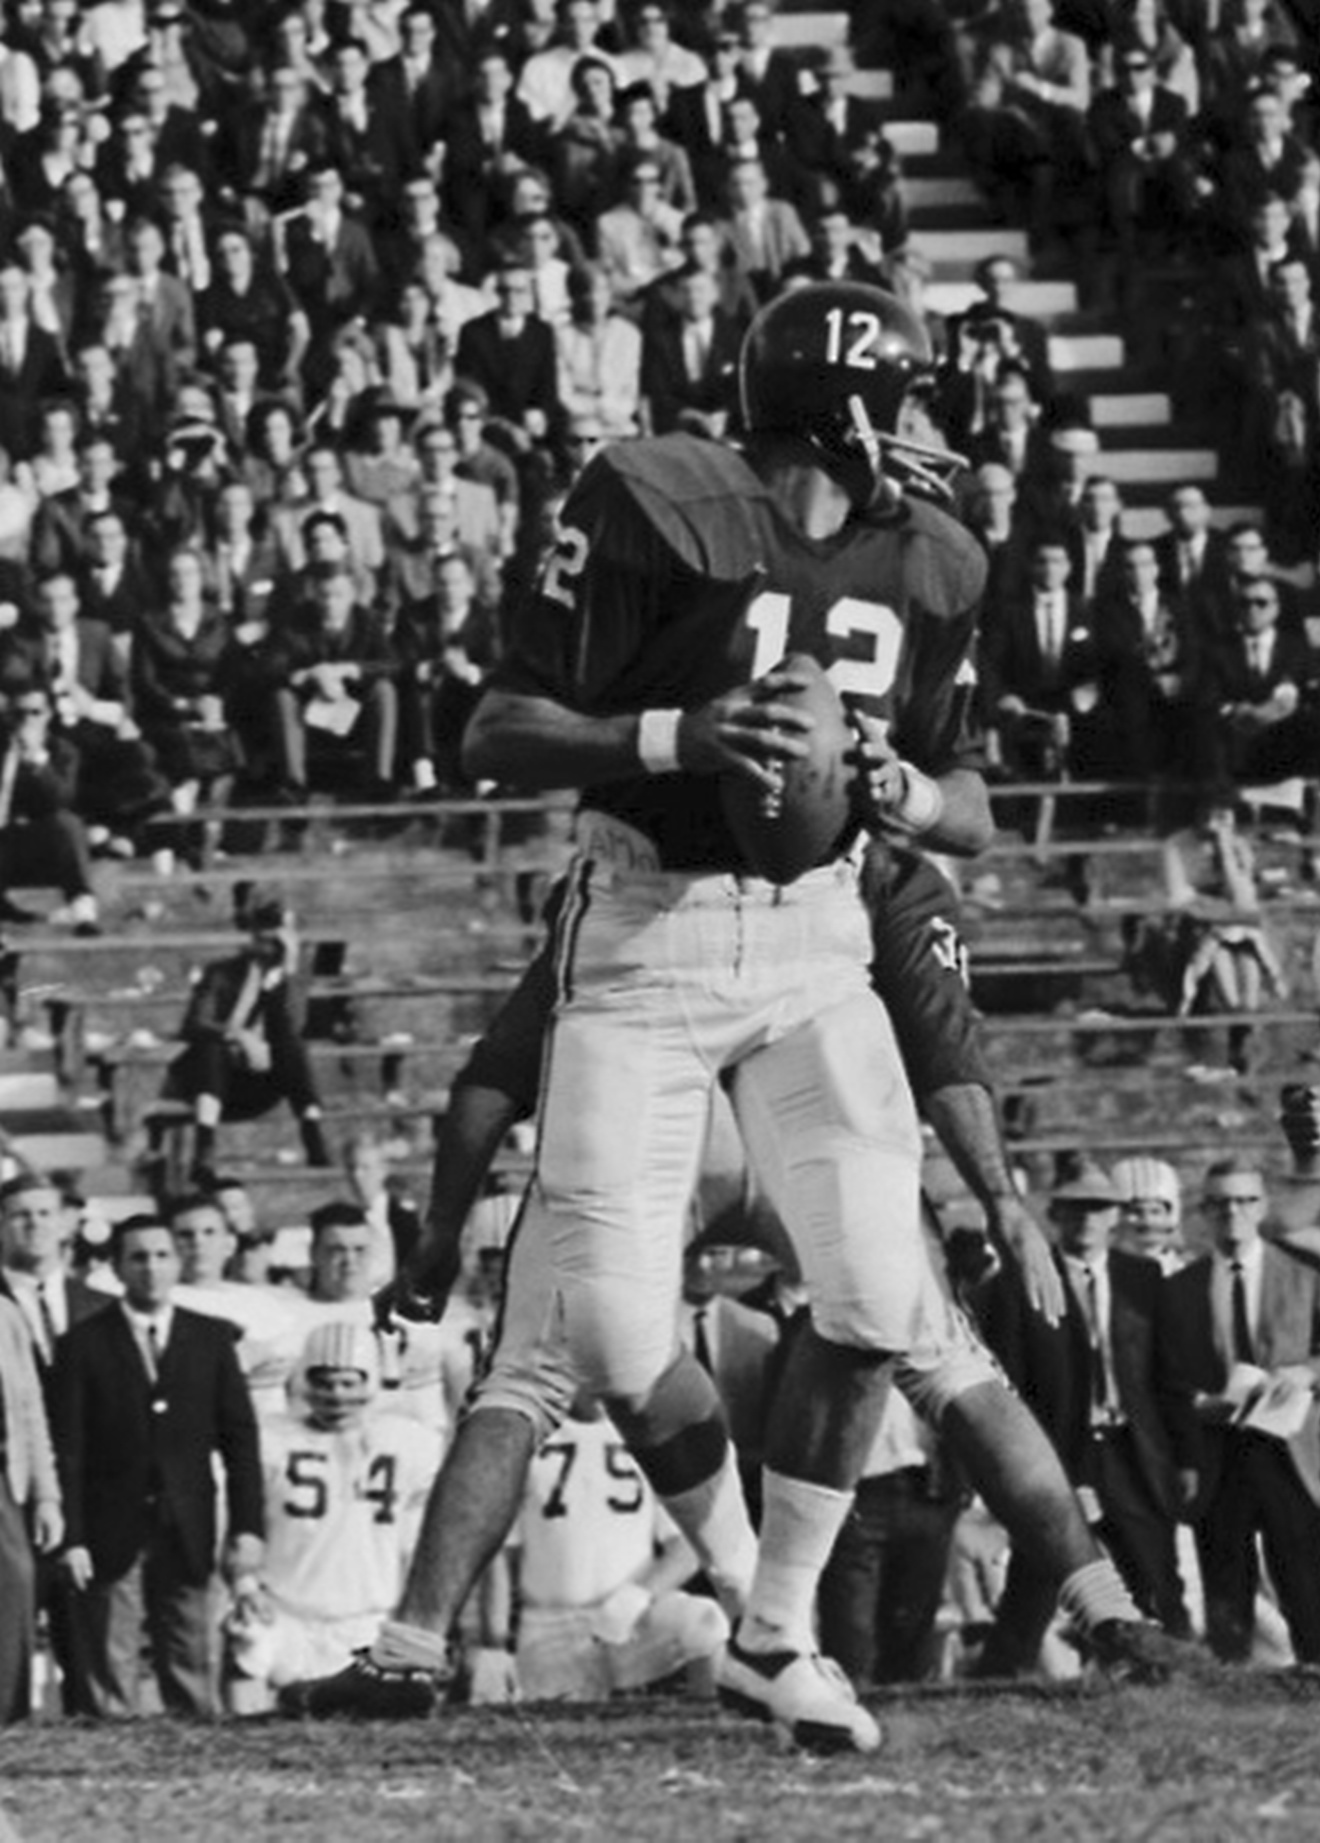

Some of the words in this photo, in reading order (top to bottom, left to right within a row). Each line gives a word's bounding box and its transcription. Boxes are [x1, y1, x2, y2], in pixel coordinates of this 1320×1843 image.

[826, 308, 881, 369] 12
[747, 591, 903, 697] 12
[283, 1450, 399, 1525] 54
[540, 1442, 644, 1520] 75
